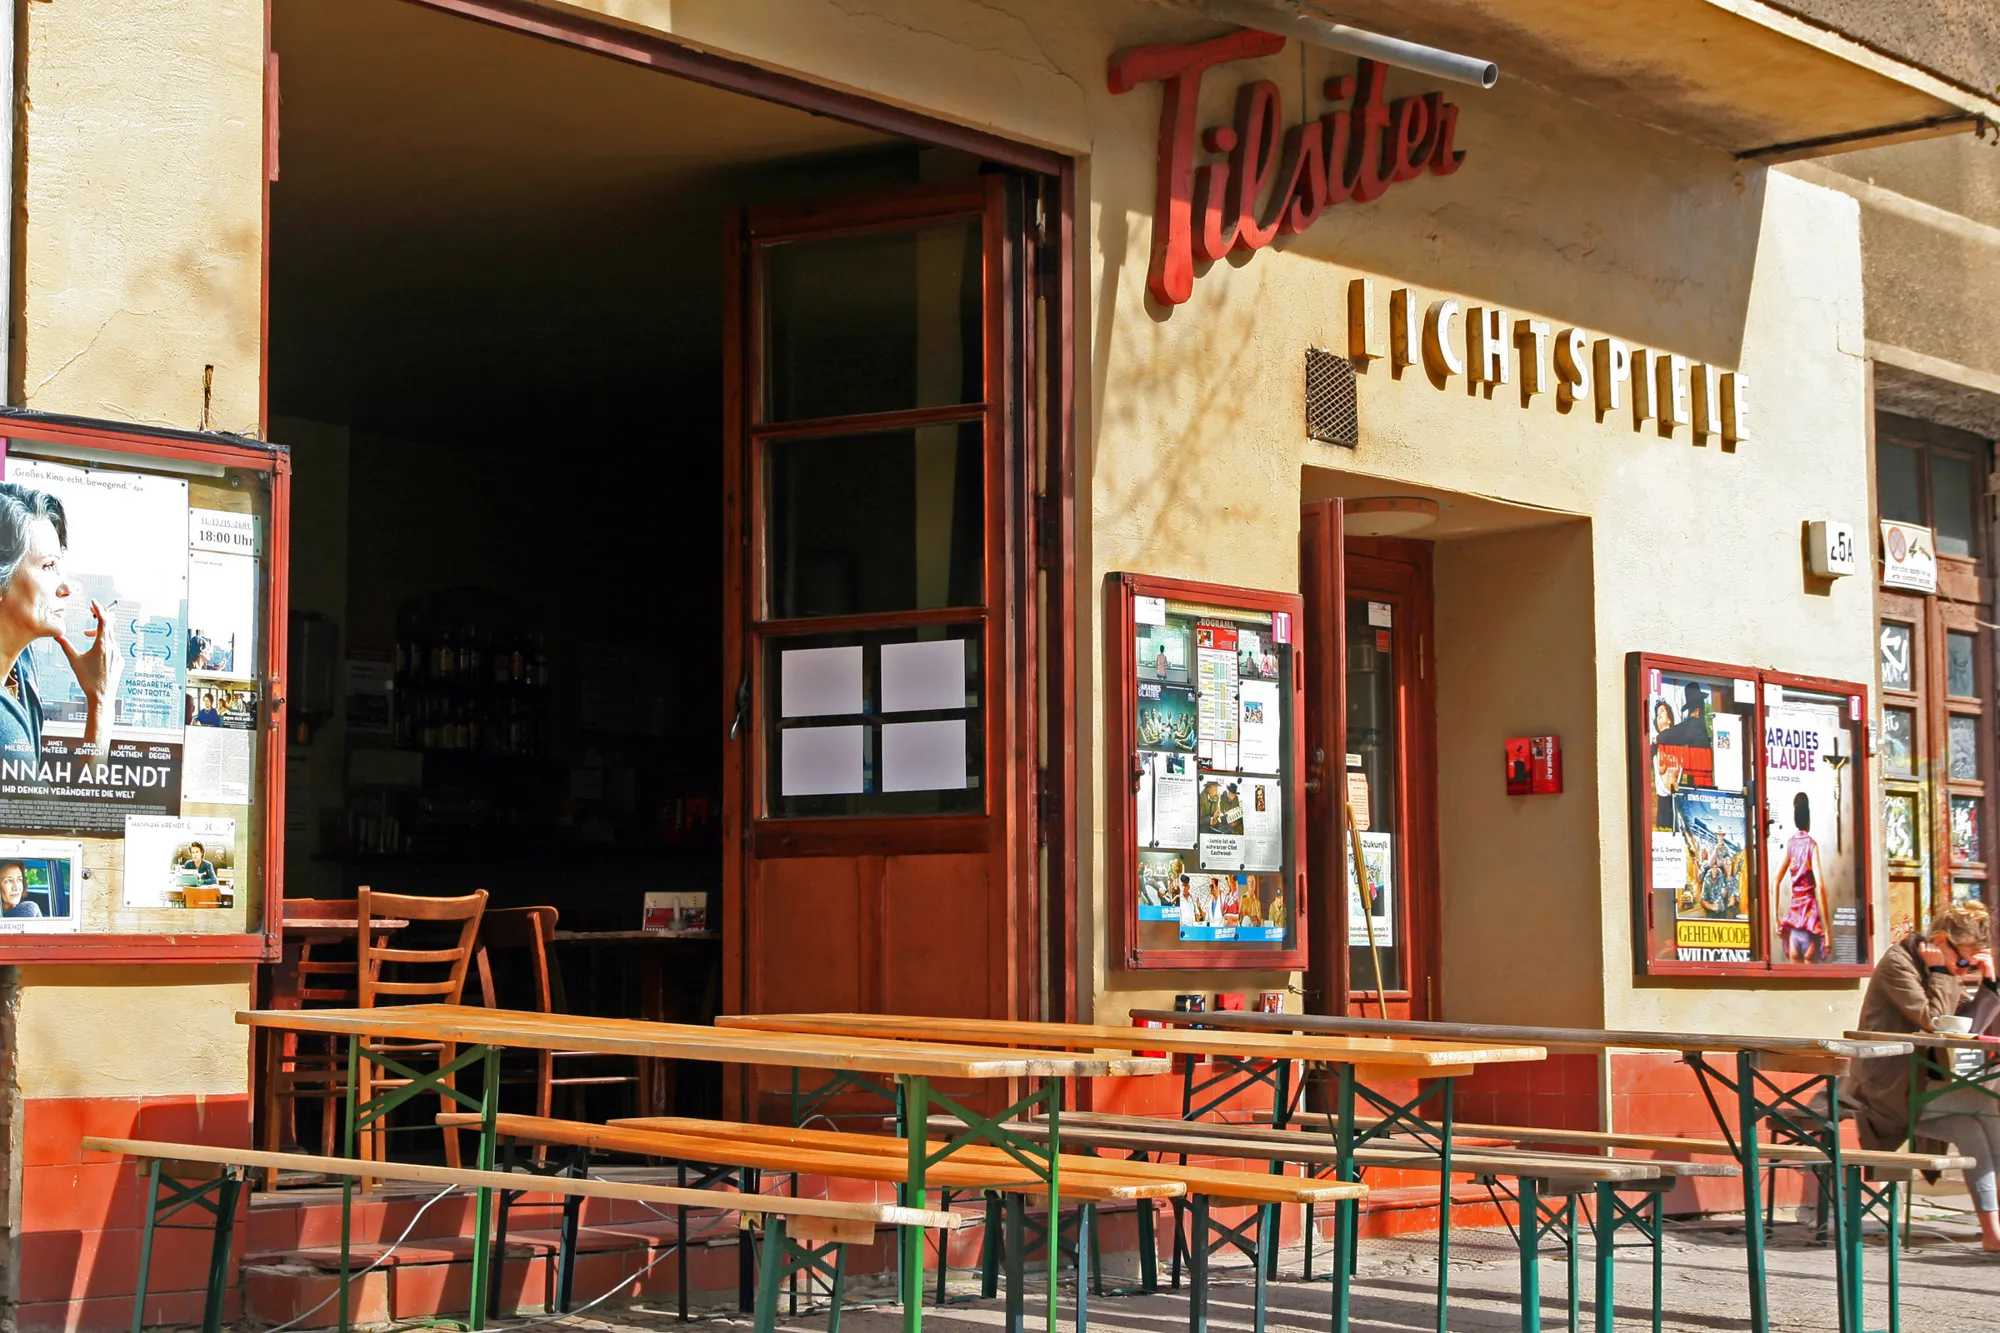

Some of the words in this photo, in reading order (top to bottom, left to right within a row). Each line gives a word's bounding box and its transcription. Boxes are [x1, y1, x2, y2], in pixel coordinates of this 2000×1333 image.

[1107, 27, 1467, 306] Tilsiter
[1348, 278, 1750, 442] LICHTSPIELE
[199, 530, 231, 544] 18:00
[233, 533, 255, 547] Uhr
[125, 679, 173, 690] MARGARETHE
[127, 687, 143, 695] VON
[144, 689, 171, 697] TROTTA
[1765, 727, 1819, 750] ARADIES
[4, 744, 36, 753] MILBERG
[42, 746, 68, 755] McTEER
[74, 747, 105, 756] JENTSCH
[111, 750, 143, 759] NOETHEN
[149, 752, 171, 760] DEGEN
[78, 763, 171, 788] ARENDT
[2, 785, 17, 794] IHR
[17, 785, 49, 795] DENKEN
[51, 786, 100, 798] VERÄNDERTE
[101, 789, 114, 798] DIE
[115, 790, 136, 799] WELT
[131, 821, 159, 829] HANNAH
[1679, 925, 1751, 944] GEHEIMCODE
